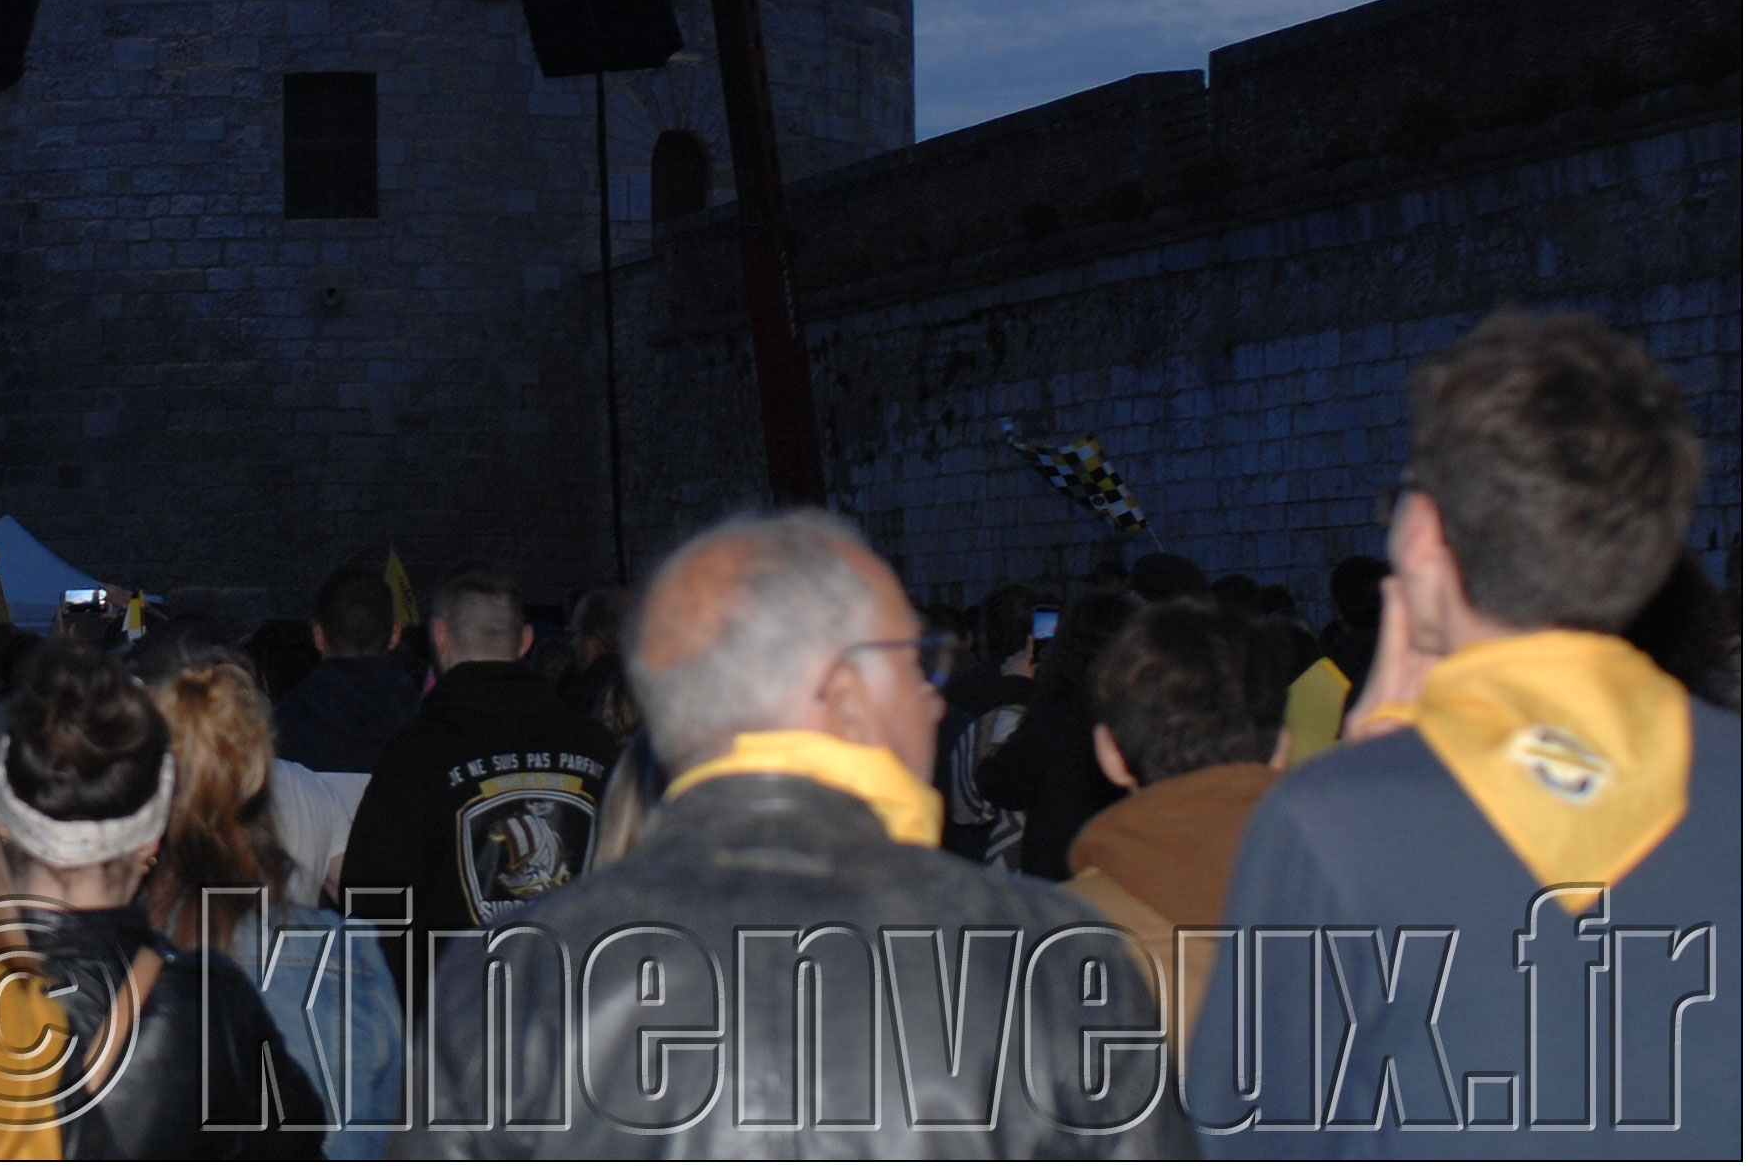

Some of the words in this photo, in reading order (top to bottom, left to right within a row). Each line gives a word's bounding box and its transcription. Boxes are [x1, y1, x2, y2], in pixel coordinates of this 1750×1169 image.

[448, 766, 465, 787] JE
[466, 759, 488, 777] NE
[492, 753, 519, 771] SUIS
[526, 752, 551, 769] PAS
